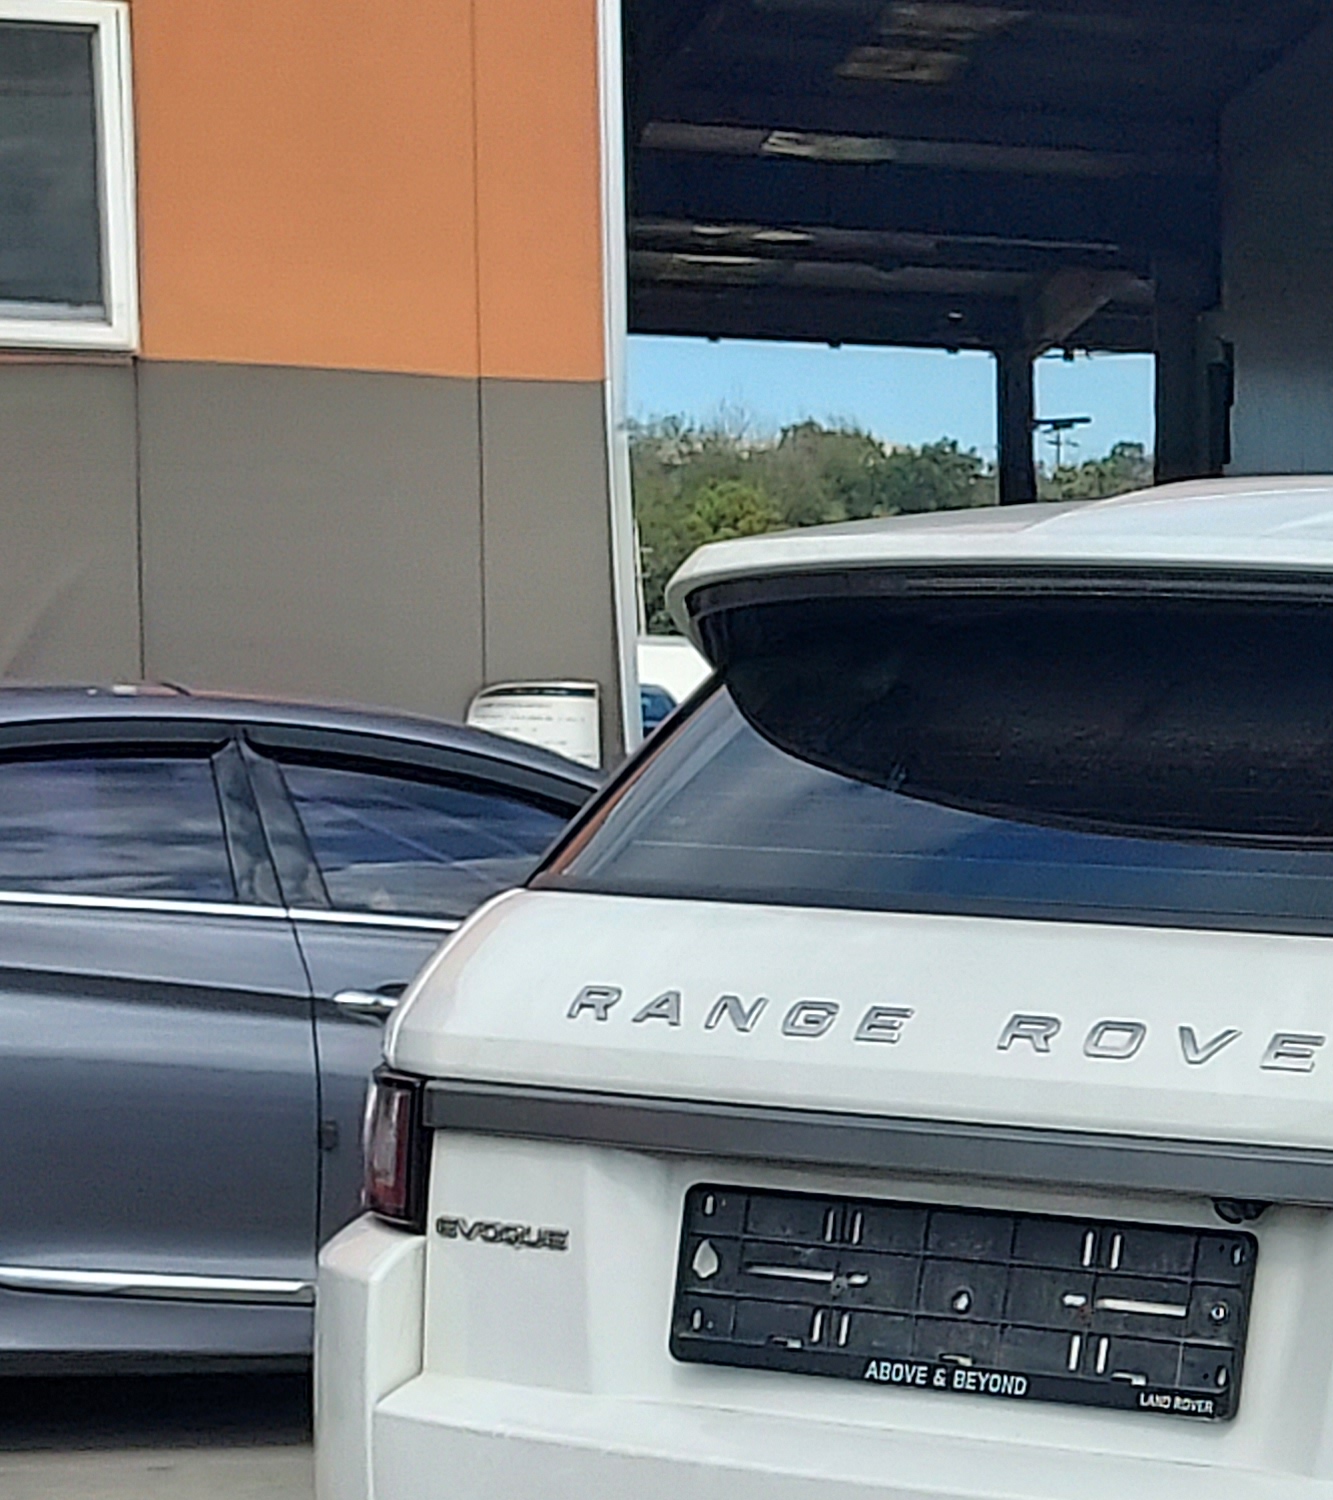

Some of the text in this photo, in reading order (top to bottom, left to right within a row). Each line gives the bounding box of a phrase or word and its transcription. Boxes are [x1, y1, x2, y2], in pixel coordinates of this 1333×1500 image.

[566, 985, 915, 1044] RANGE
[435, 1217, 570, 1251] EVOQUE
[864, 1359, 1028, 1396] ABOVE & BEYOND
[1139, 1392, 1214, 1414] LAND ROVER
